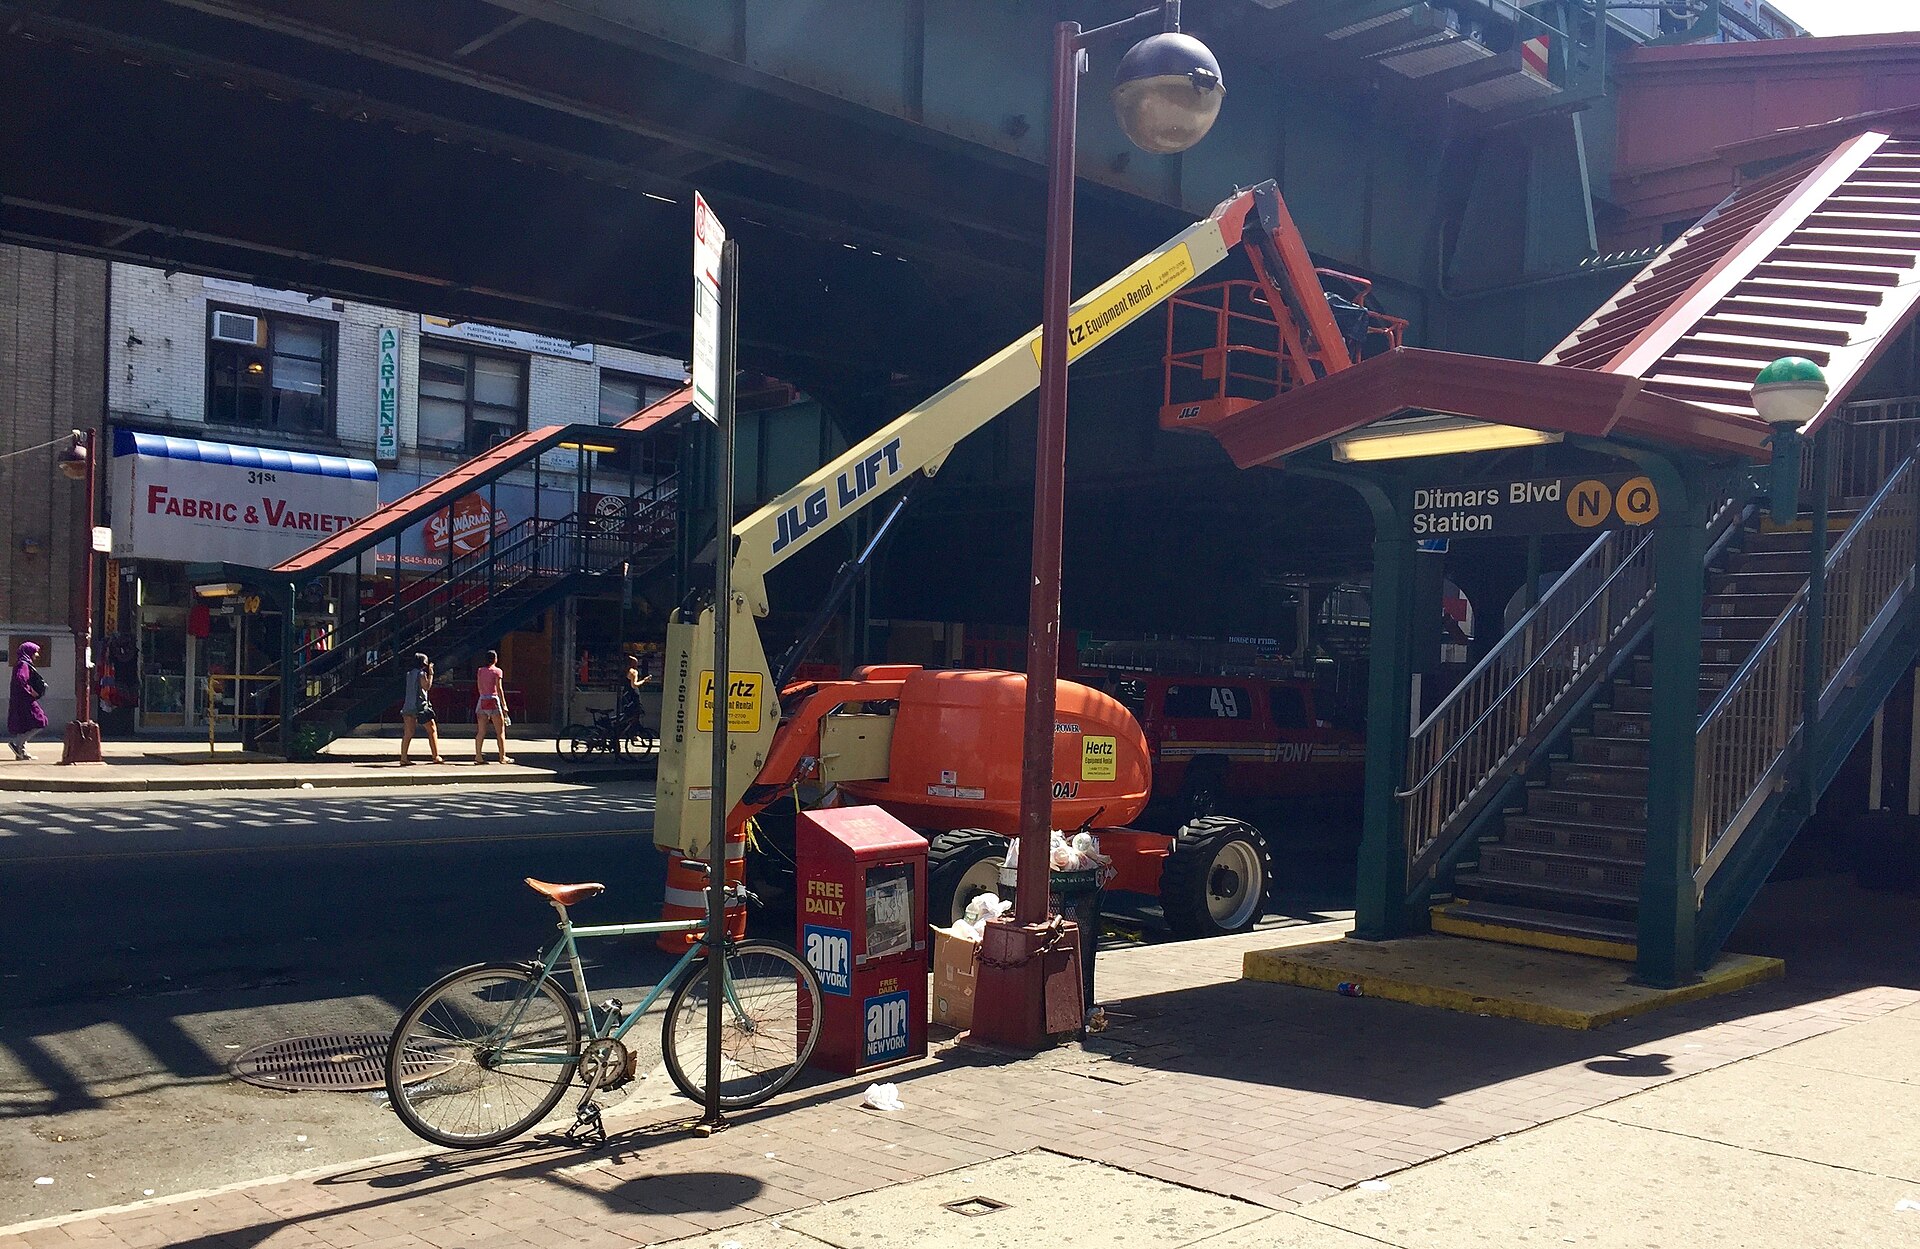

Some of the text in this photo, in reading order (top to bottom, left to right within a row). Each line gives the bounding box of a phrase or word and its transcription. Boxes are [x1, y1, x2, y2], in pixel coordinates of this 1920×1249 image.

[1086, 297, 1128, 336] Equipment
[1126, 279, 1154, 308] Rental
[379, 329, 397, 447] APARTMENTS
[1178, 406, 1200, 419] JLG
[147, 485, 238, 523] FABRIC
[243, 505, 259, 524] &
[771, 435, 903, 556] JLG LIFT
[1414, 480, 1562, 510] Ditmars Blvd
[1578, 487, 1651, 517] N Q
[431, 510, 505, 541] SHWARMAIA
[1413, 511, 1493, 535] Station
[387, 554, 443, 566] 71-545-1800
[676, 650, 688, 743] 468-60-0159
[705, 679, 755, 697] Hrtz
[735, 701, 754, 710] Rental
[1210, 687, 1238, 718] 49
[1086, 741, 1113, 755] Hertz
[1274, 742, 1313, 763] FDNY
[808, 880, 844, 899] FREE
[805, 897, 846, 917] DAILY
[807, 932, 848, 974] am
[878, 985, 899, 995] DAILY
[880, 978, 898, 987] FREE
[867, 999, 906, 1042] am
